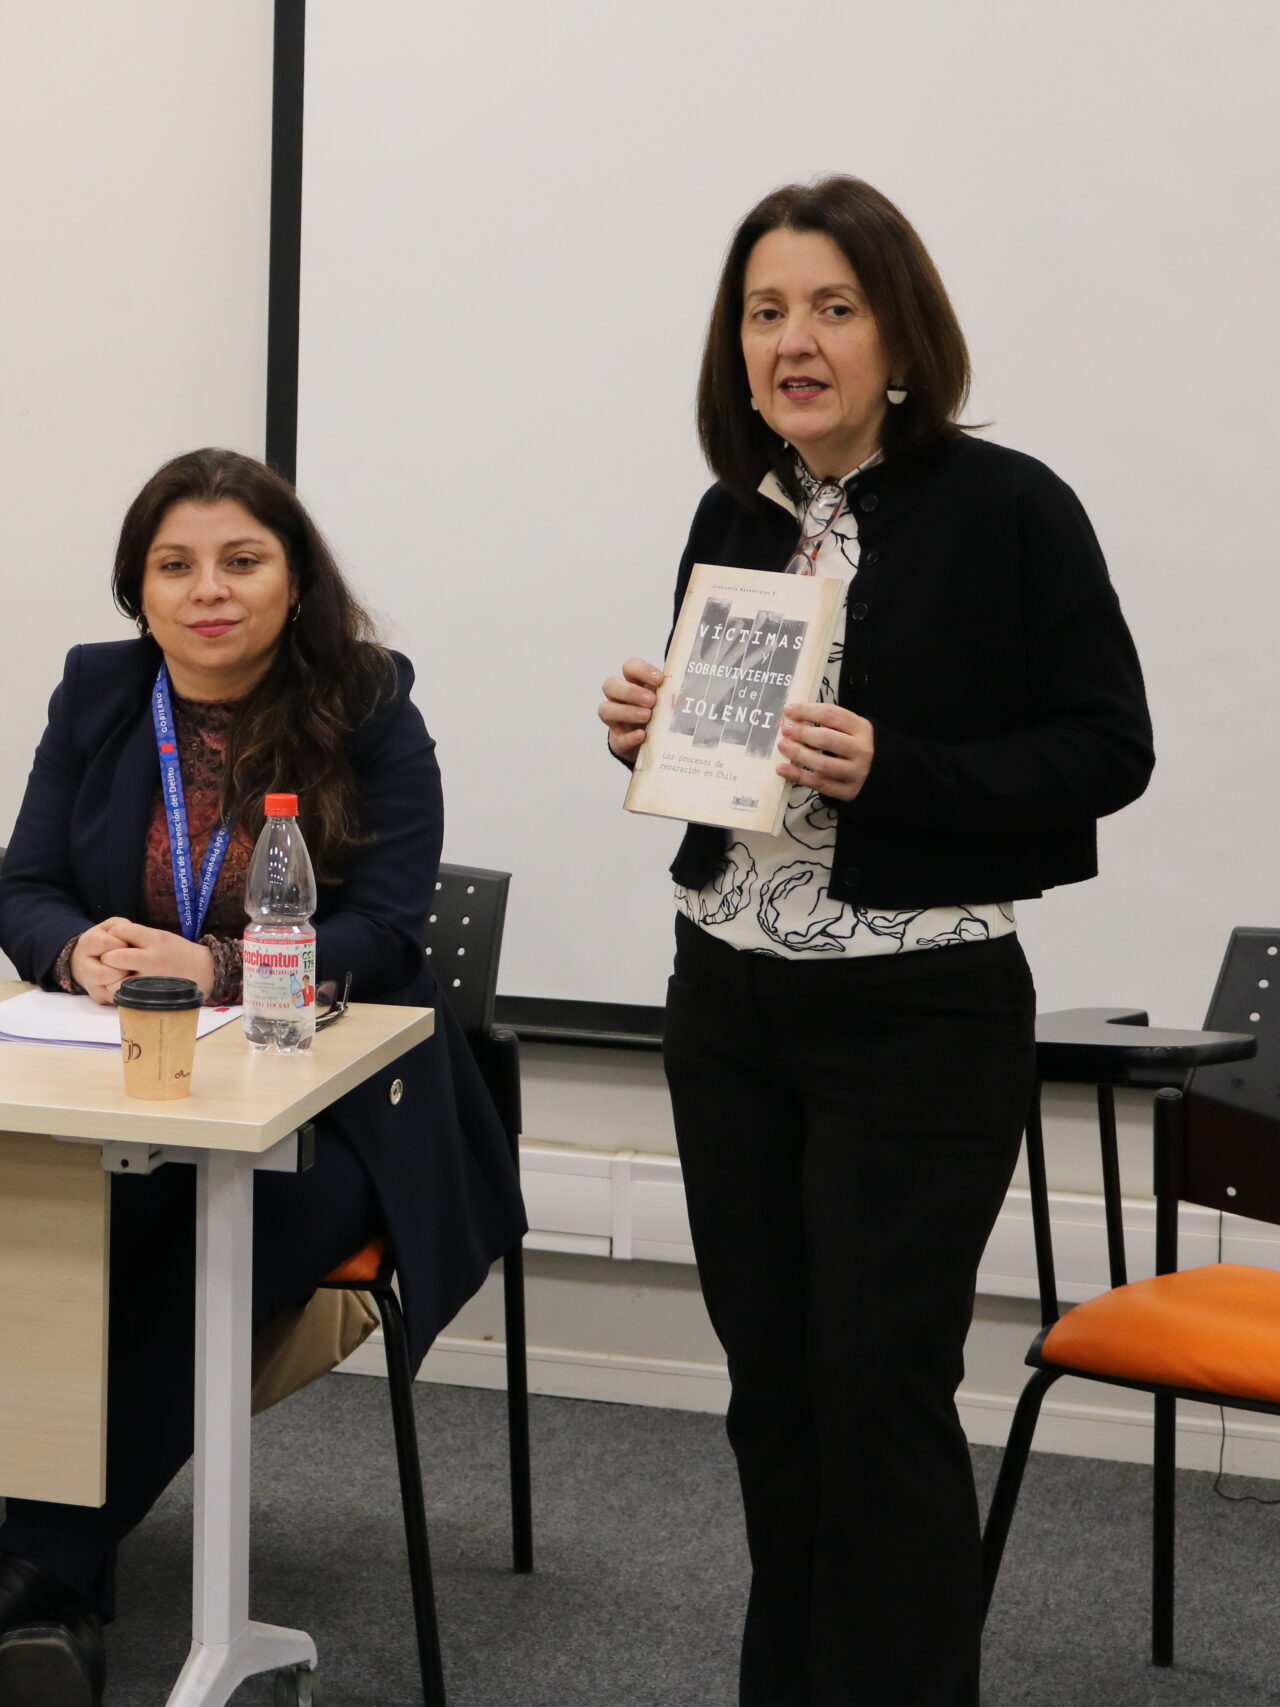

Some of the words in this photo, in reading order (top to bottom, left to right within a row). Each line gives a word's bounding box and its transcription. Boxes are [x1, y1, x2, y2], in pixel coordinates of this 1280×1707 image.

[700, 623, 803, 650] VÍCTIMAS
[761, 652, 770, 664] y
[687, 661, 793, 687] SOBREVIVIENTES
[738, 686, 758, 700] de
[156, 692, 168, 733] GOBIERNO
[662, 752, 675, 760] Los
[678, 755, 712, 767] procesos
[714, 760, 724, 769] de
[168, 767, 177, 793] Delito
[659, 762, 701, 775] reparación
[716, 771, 738, 781] Chile
[170, 794, 178, 807] del
[172, 808, 184, 855] Prevención
[215, 836, 224, 847] de
[177, 856, 185, 866] de
[201, 848, 220, 895] Prevención
